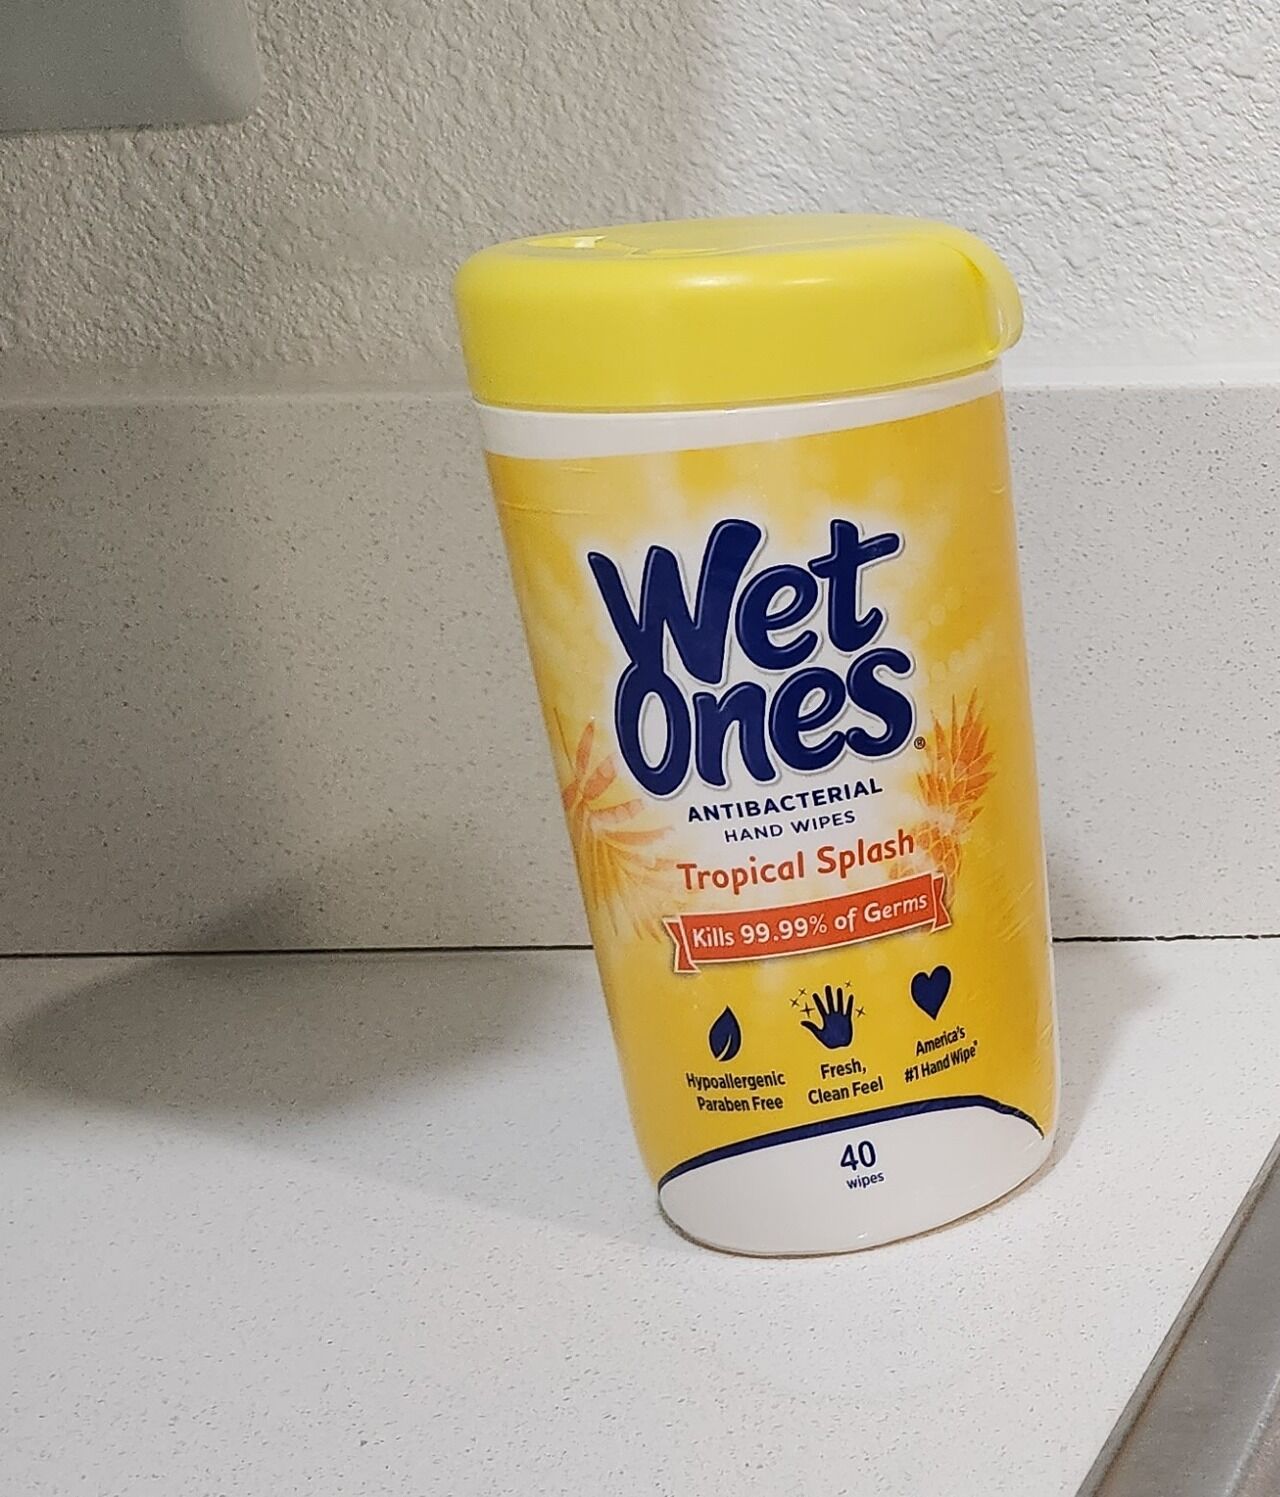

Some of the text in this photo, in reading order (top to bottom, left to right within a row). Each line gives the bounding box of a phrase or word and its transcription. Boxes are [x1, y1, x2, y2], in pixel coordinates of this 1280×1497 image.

[587, 518, 900, 684] Wet
[687, 777, 883, 822] ANTIBACTERIAL
[724, 810, 856, 843] HAND WIPES
[676, 828, 914, 895] Tropical Splash
[692, 892, 929, 948] Kills 99.99% of Germs
[915, 1025, 966, 1056] America's
[686, 1070, 786, 1091] Hypoallergenic
[820, 1058, 867, 1079] Fresh,
[904, 1065, 919, 1083] #1
[920, 1053, 950, 1078] Hand
[697, 1096, 784, 1112] Paraben Free
[808, 1076, 884, 1105] Clean Feel
[840, 1140, 877, 1171] 40
[846, 1171, 885, 1189] wipes
